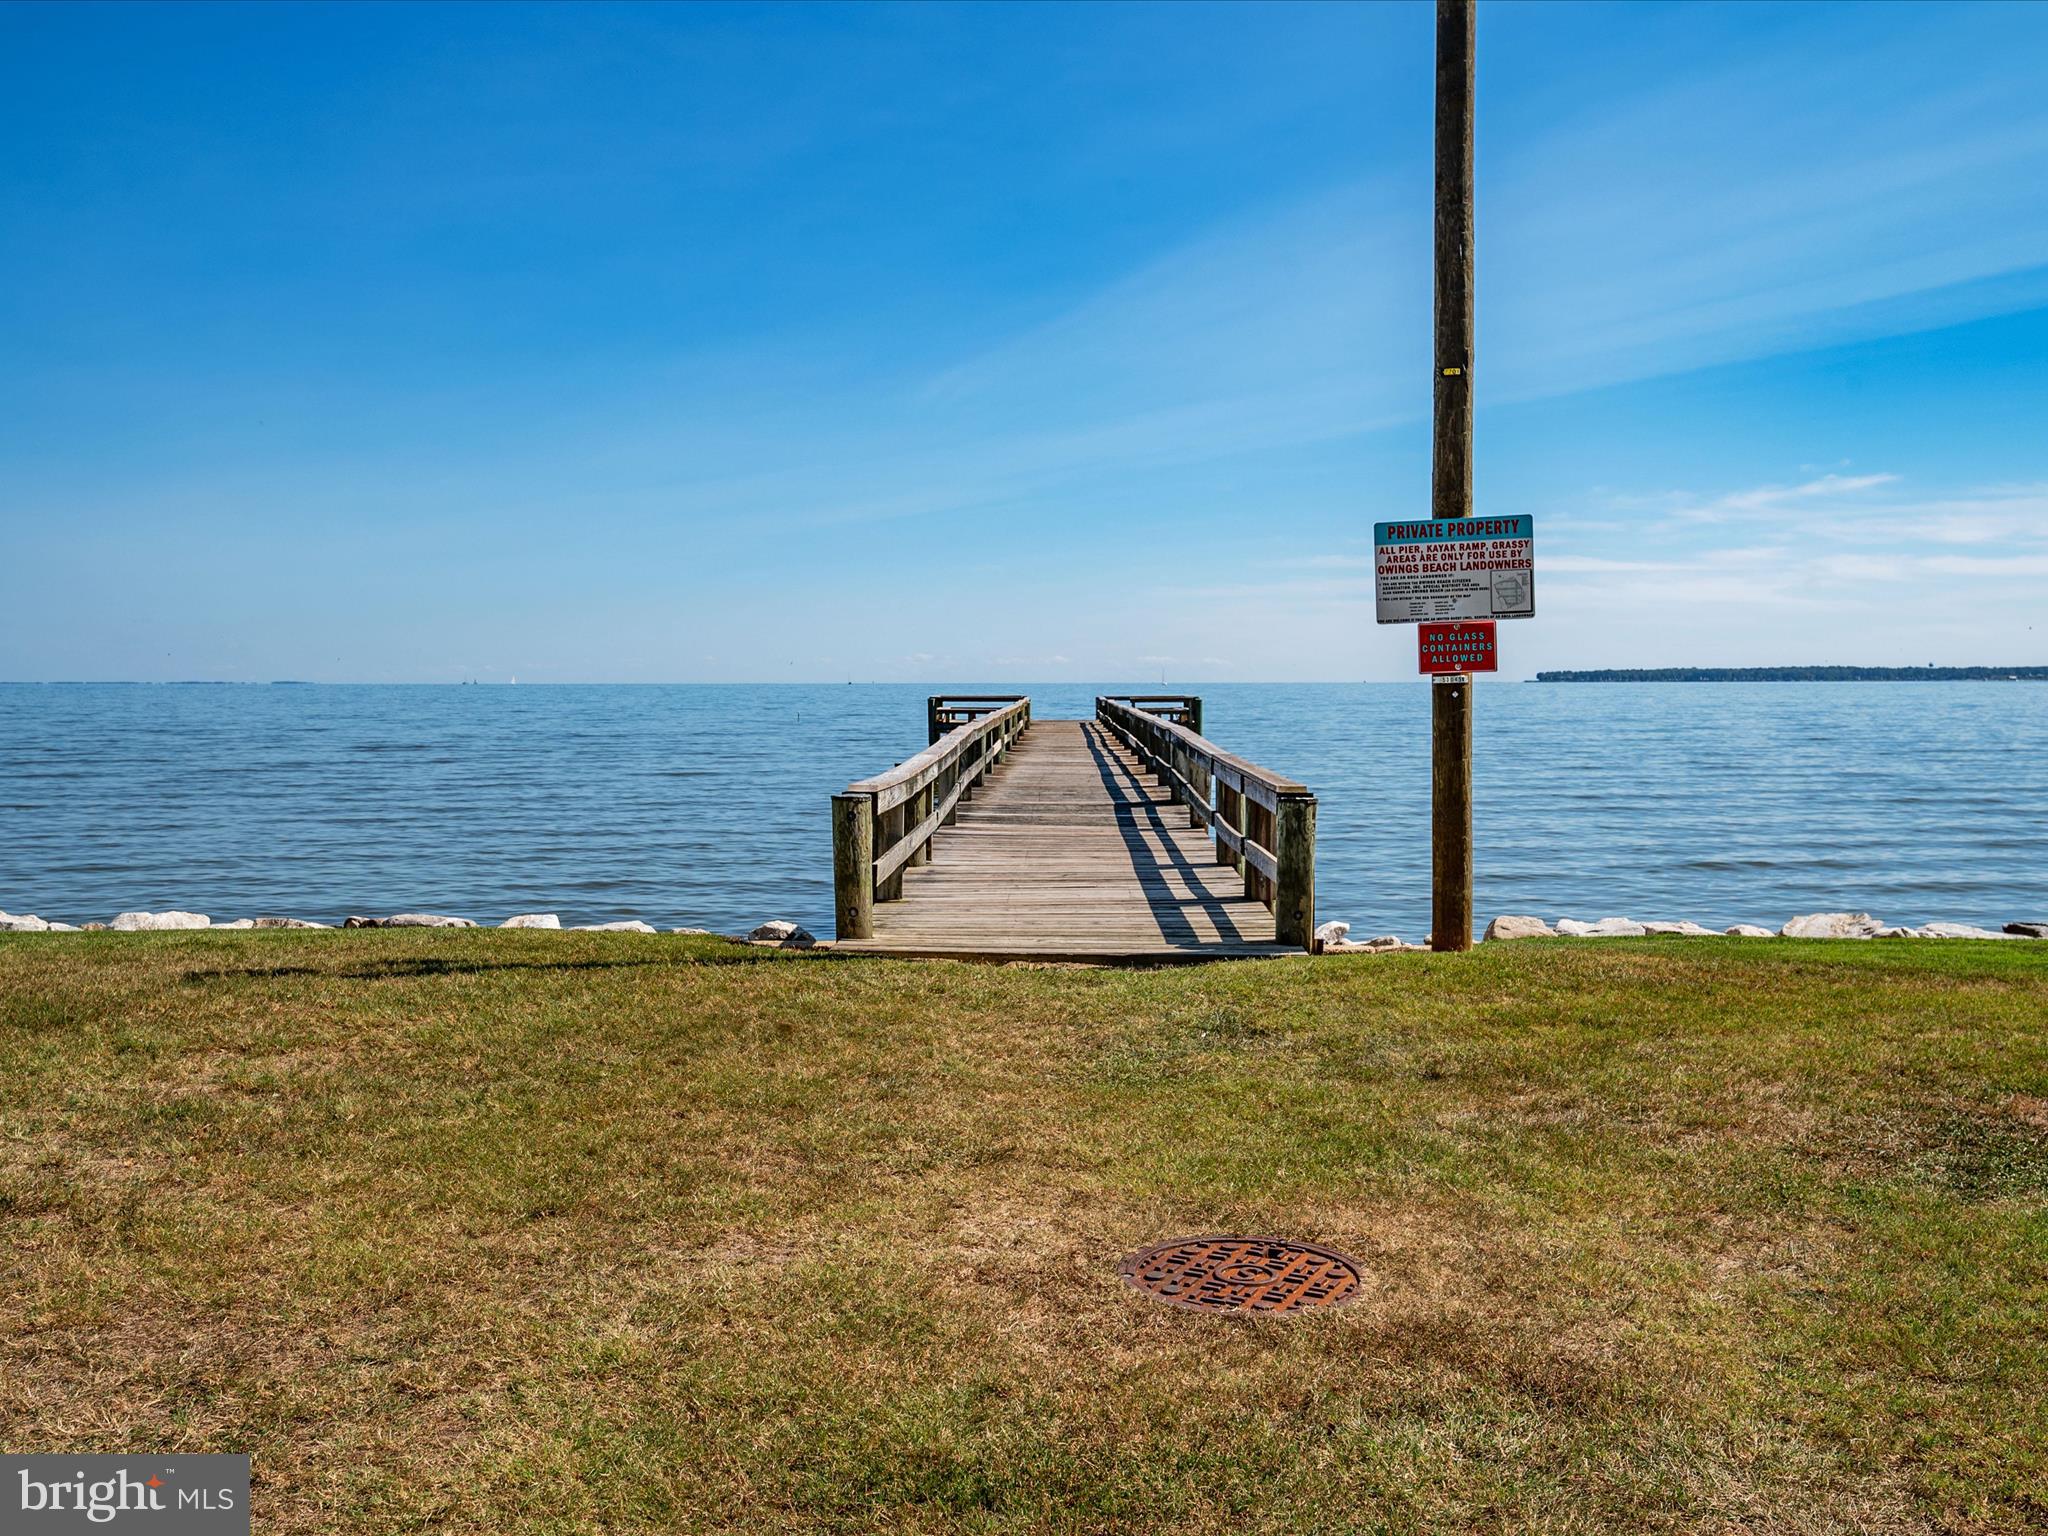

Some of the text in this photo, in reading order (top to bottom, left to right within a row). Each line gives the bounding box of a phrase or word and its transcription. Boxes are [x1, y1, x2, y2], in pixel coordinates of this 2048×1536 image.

[1387, 519, 1519, 539] PRIVATE PROPERTY
[1379, 540, 1530, 555] ALL PIER, KAYAK RAMP, GRASSY
[1386, 549, 1523, 564] AREAS ARE ONLY FOR USE BY
[1378, 558, 1532, 575] OWINGS BEACH LANDOWNERS
[1429, 632, 1485, 641] NO GLASS
[1422, 642, 1493, 653] CONTAINERS
[1431, 654, 1483, 663] ALLOWED
